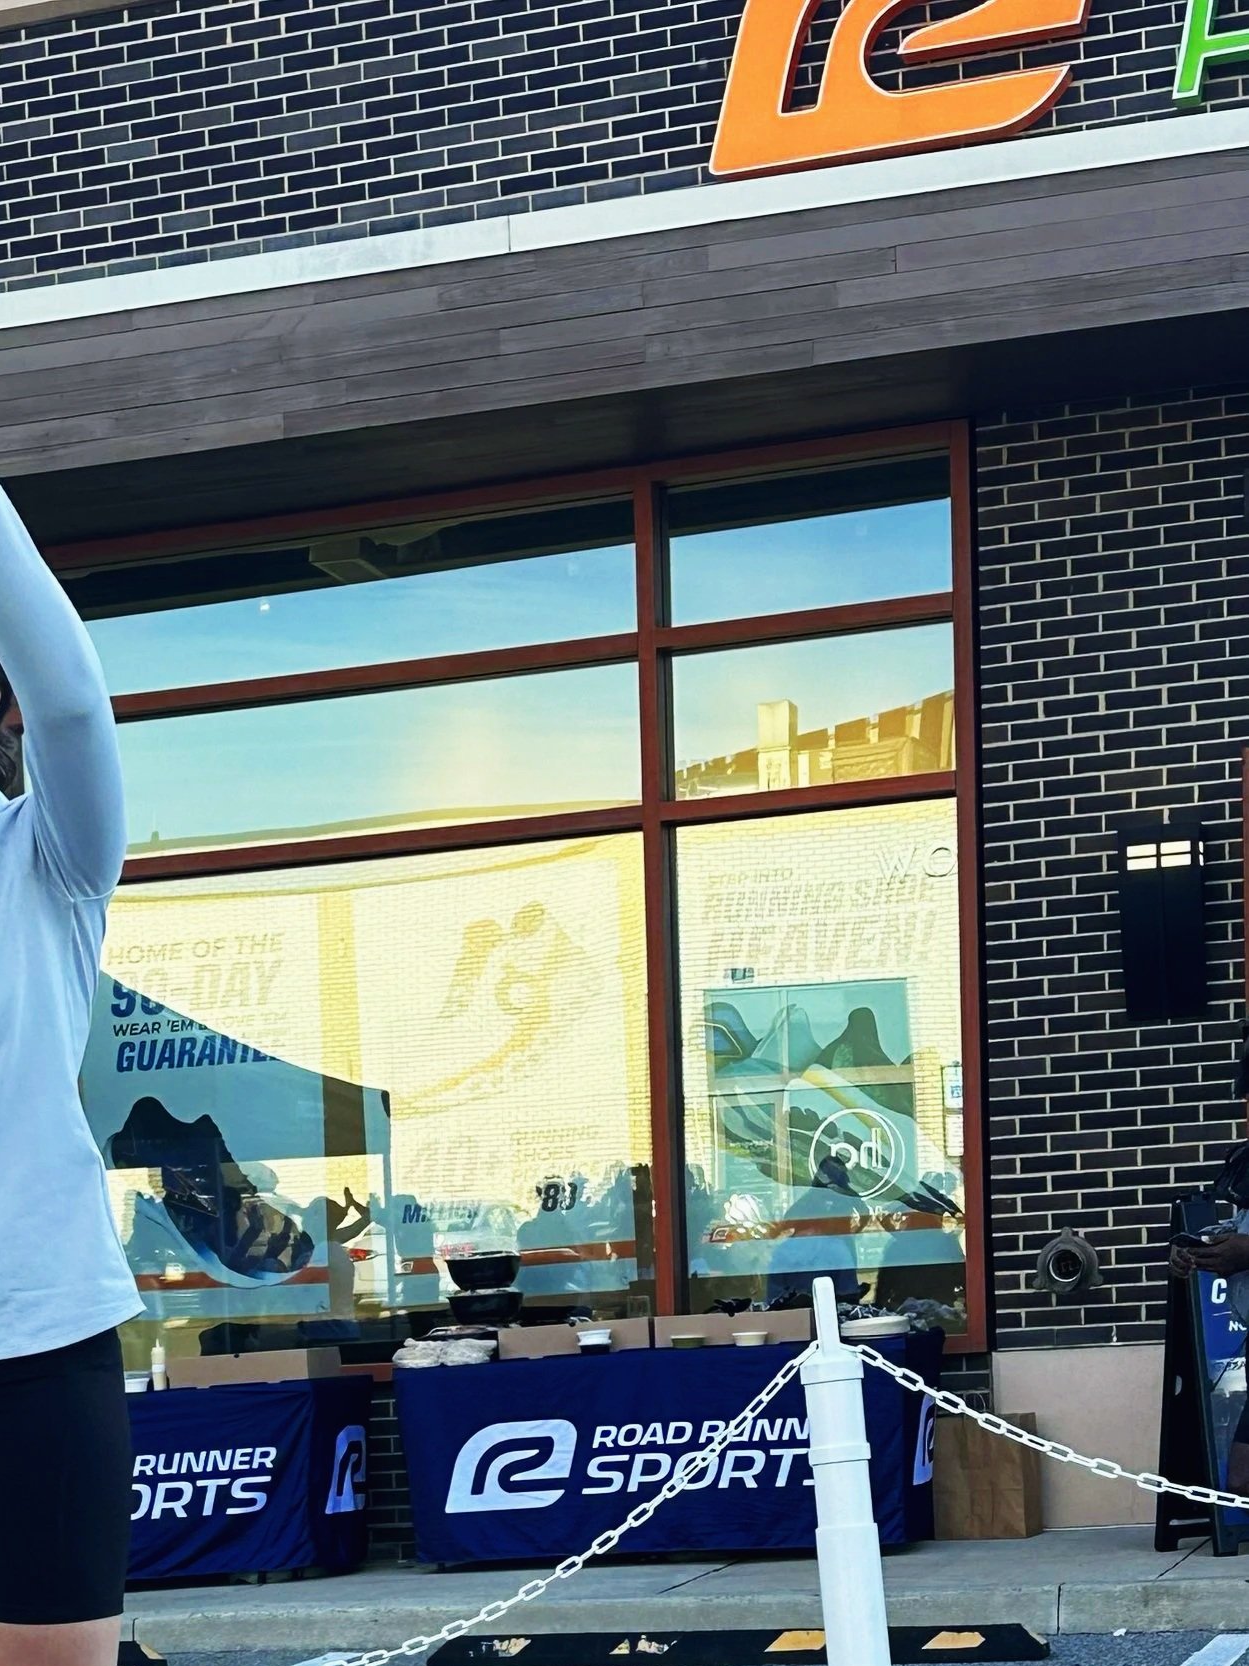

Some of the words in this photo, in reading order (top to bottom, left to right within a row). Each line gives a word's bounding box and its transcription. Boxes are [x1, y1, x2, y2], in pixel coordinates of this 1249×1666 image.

[107, 941, 184, 966] HOME
[191, 937, 227, 960] OF
[234, 932, 286, 955] THE
[112, 1021, 162, 1037] WEAR
[592, 1421, 693, 1449] ROAD
[698, 1417, 810, 1444] RUNN
[132, 1446, 278, 1477] RUNNER
[130, 1475, 272, 1521] ORTS
